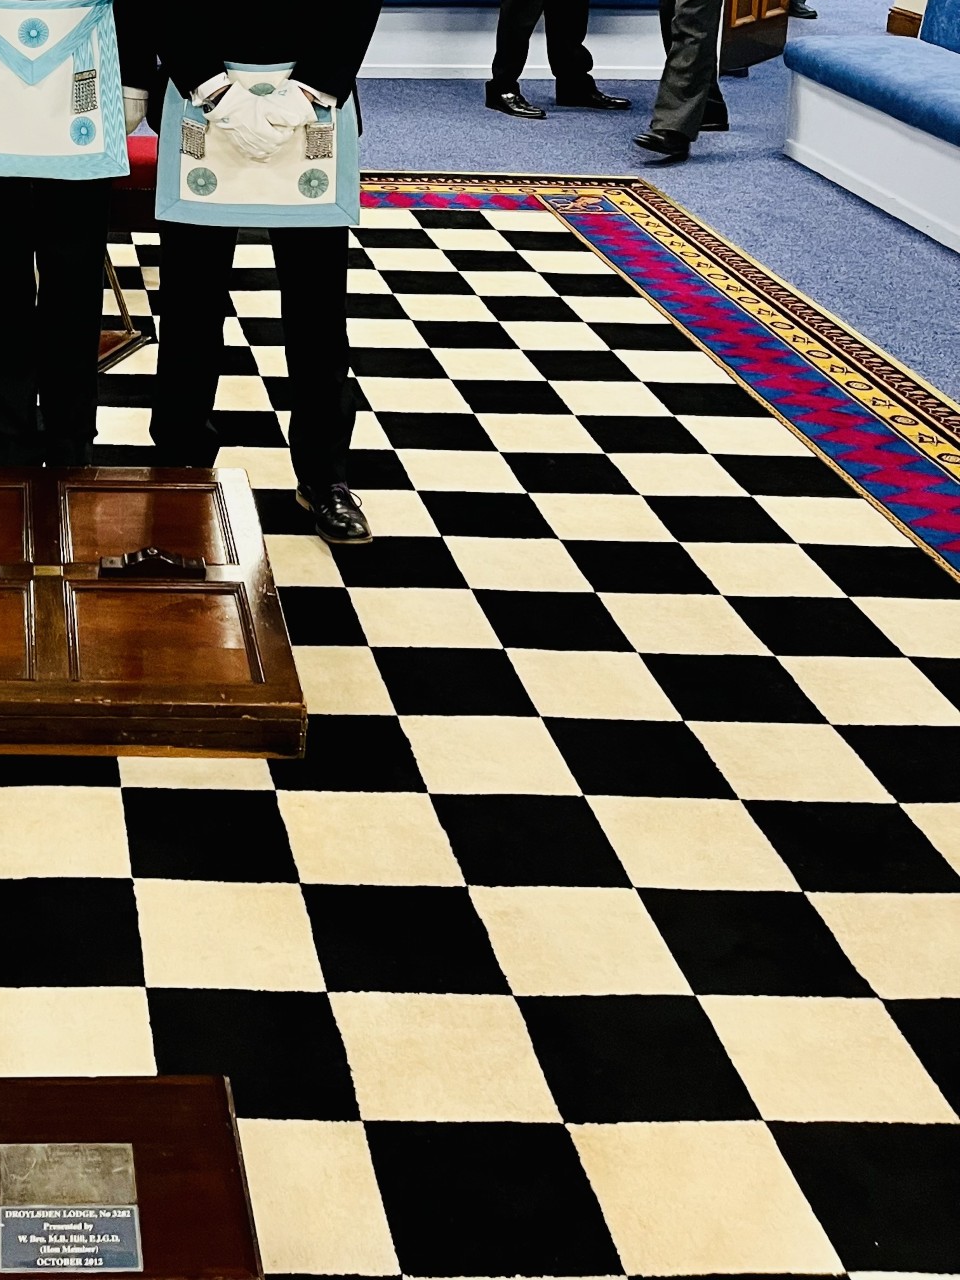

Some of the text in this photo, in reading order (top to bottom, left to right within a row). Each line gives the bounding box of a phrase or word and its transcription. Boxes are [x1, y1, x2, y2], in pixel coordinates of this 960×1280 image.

[5, 1209, 61, 1218] DROYLSDEN
[62, 1209, 98, 1219] LODGE,
[99, 1209, 112, 1218] No
[43, 1222, 94, 1232] Presented by
[61, 1245, 99, 1254] Member)
[36, 1257, 104, 1266] OCTOBER 2012
